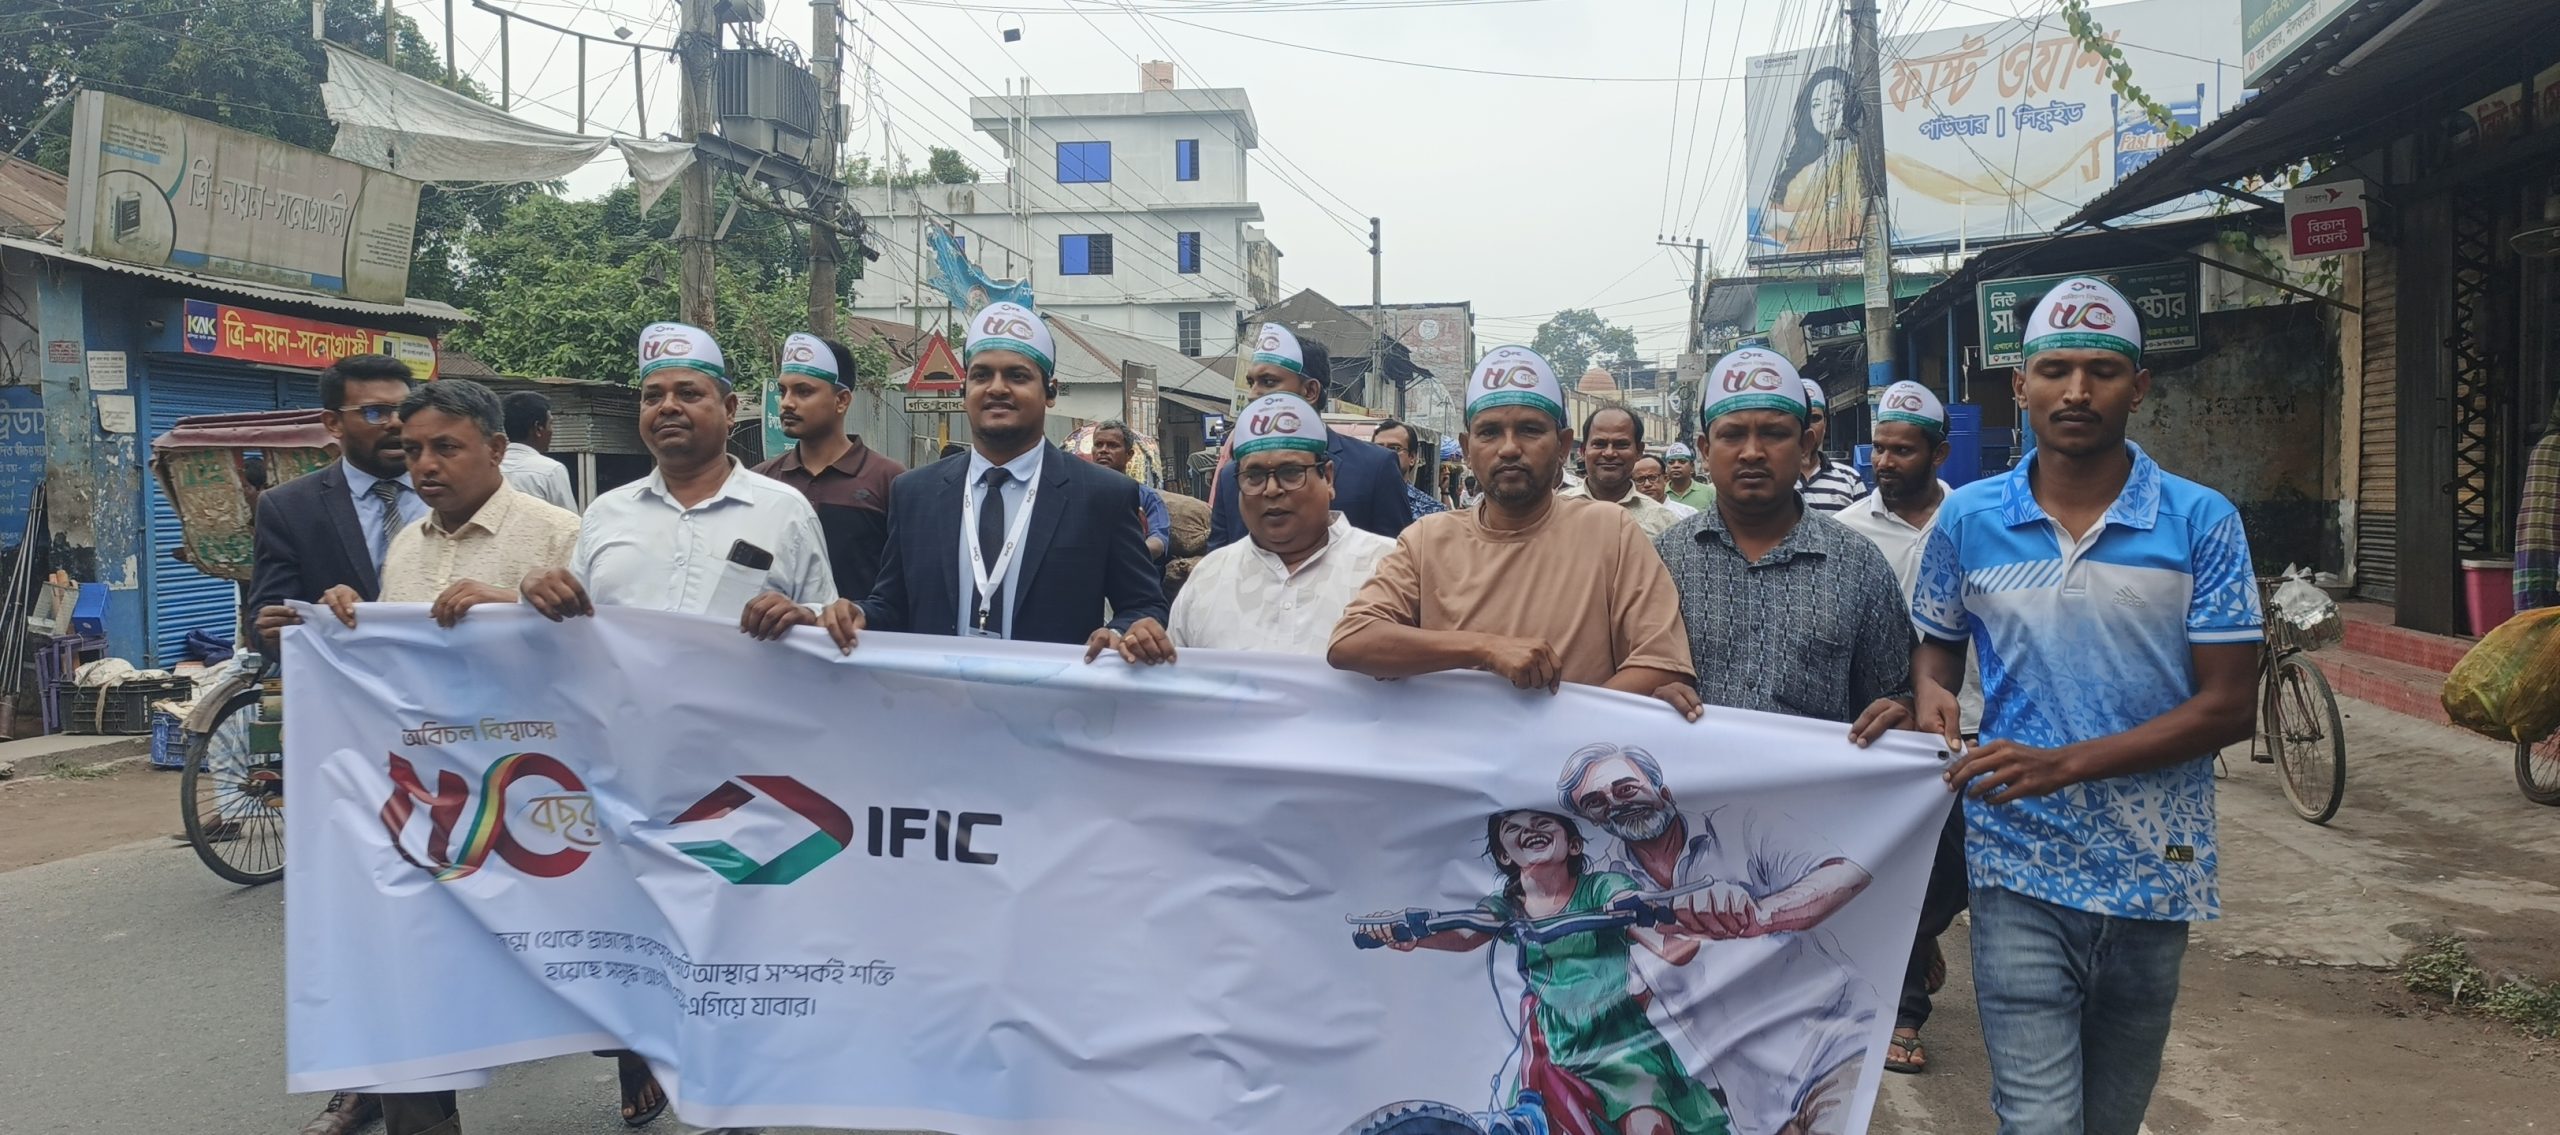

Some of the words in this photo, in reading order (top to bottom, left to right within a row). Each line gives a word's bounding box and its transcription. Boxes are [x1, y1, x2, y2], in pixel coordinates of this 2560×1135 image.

[1889, 34, 1988, 112] ফাস্ট
[1998, 29, 2120, 98] ওয়াশ
[1919, 114, 1989, 140] পাউডার
[2013, 100, 2085, 133] লিকুইড
[2119, 132, 2151, 153] Fast
[2307, 218, 2347, 233] বিকাশ
[2307, 230, 2348, 246] পেমেন্ট
[1990, 292, 2016, 309] নিউ
[223, 310, 369, 360] ত্রি-নয়ন-সনোগ্রাফী
[402, 721, 477, 747] অবিচল
[479, 718, 558, 742] বিশ্বাসের
[527, 794, 602, 847] বছর
[868, 806, 1003, 865] IFIC
[535, 930, 585, 949] থেকে
[692, 963, 760, 986] আস্থার
[765, 957, 846, 985] সম্পর্কই
[849, 959, 897, 987] শক্তি
[544, 960, 602, 982] হয়েছে
[688, 991, 747, 1019] এগিয়ে
[751, 997, 817, 1018] যাবার।
